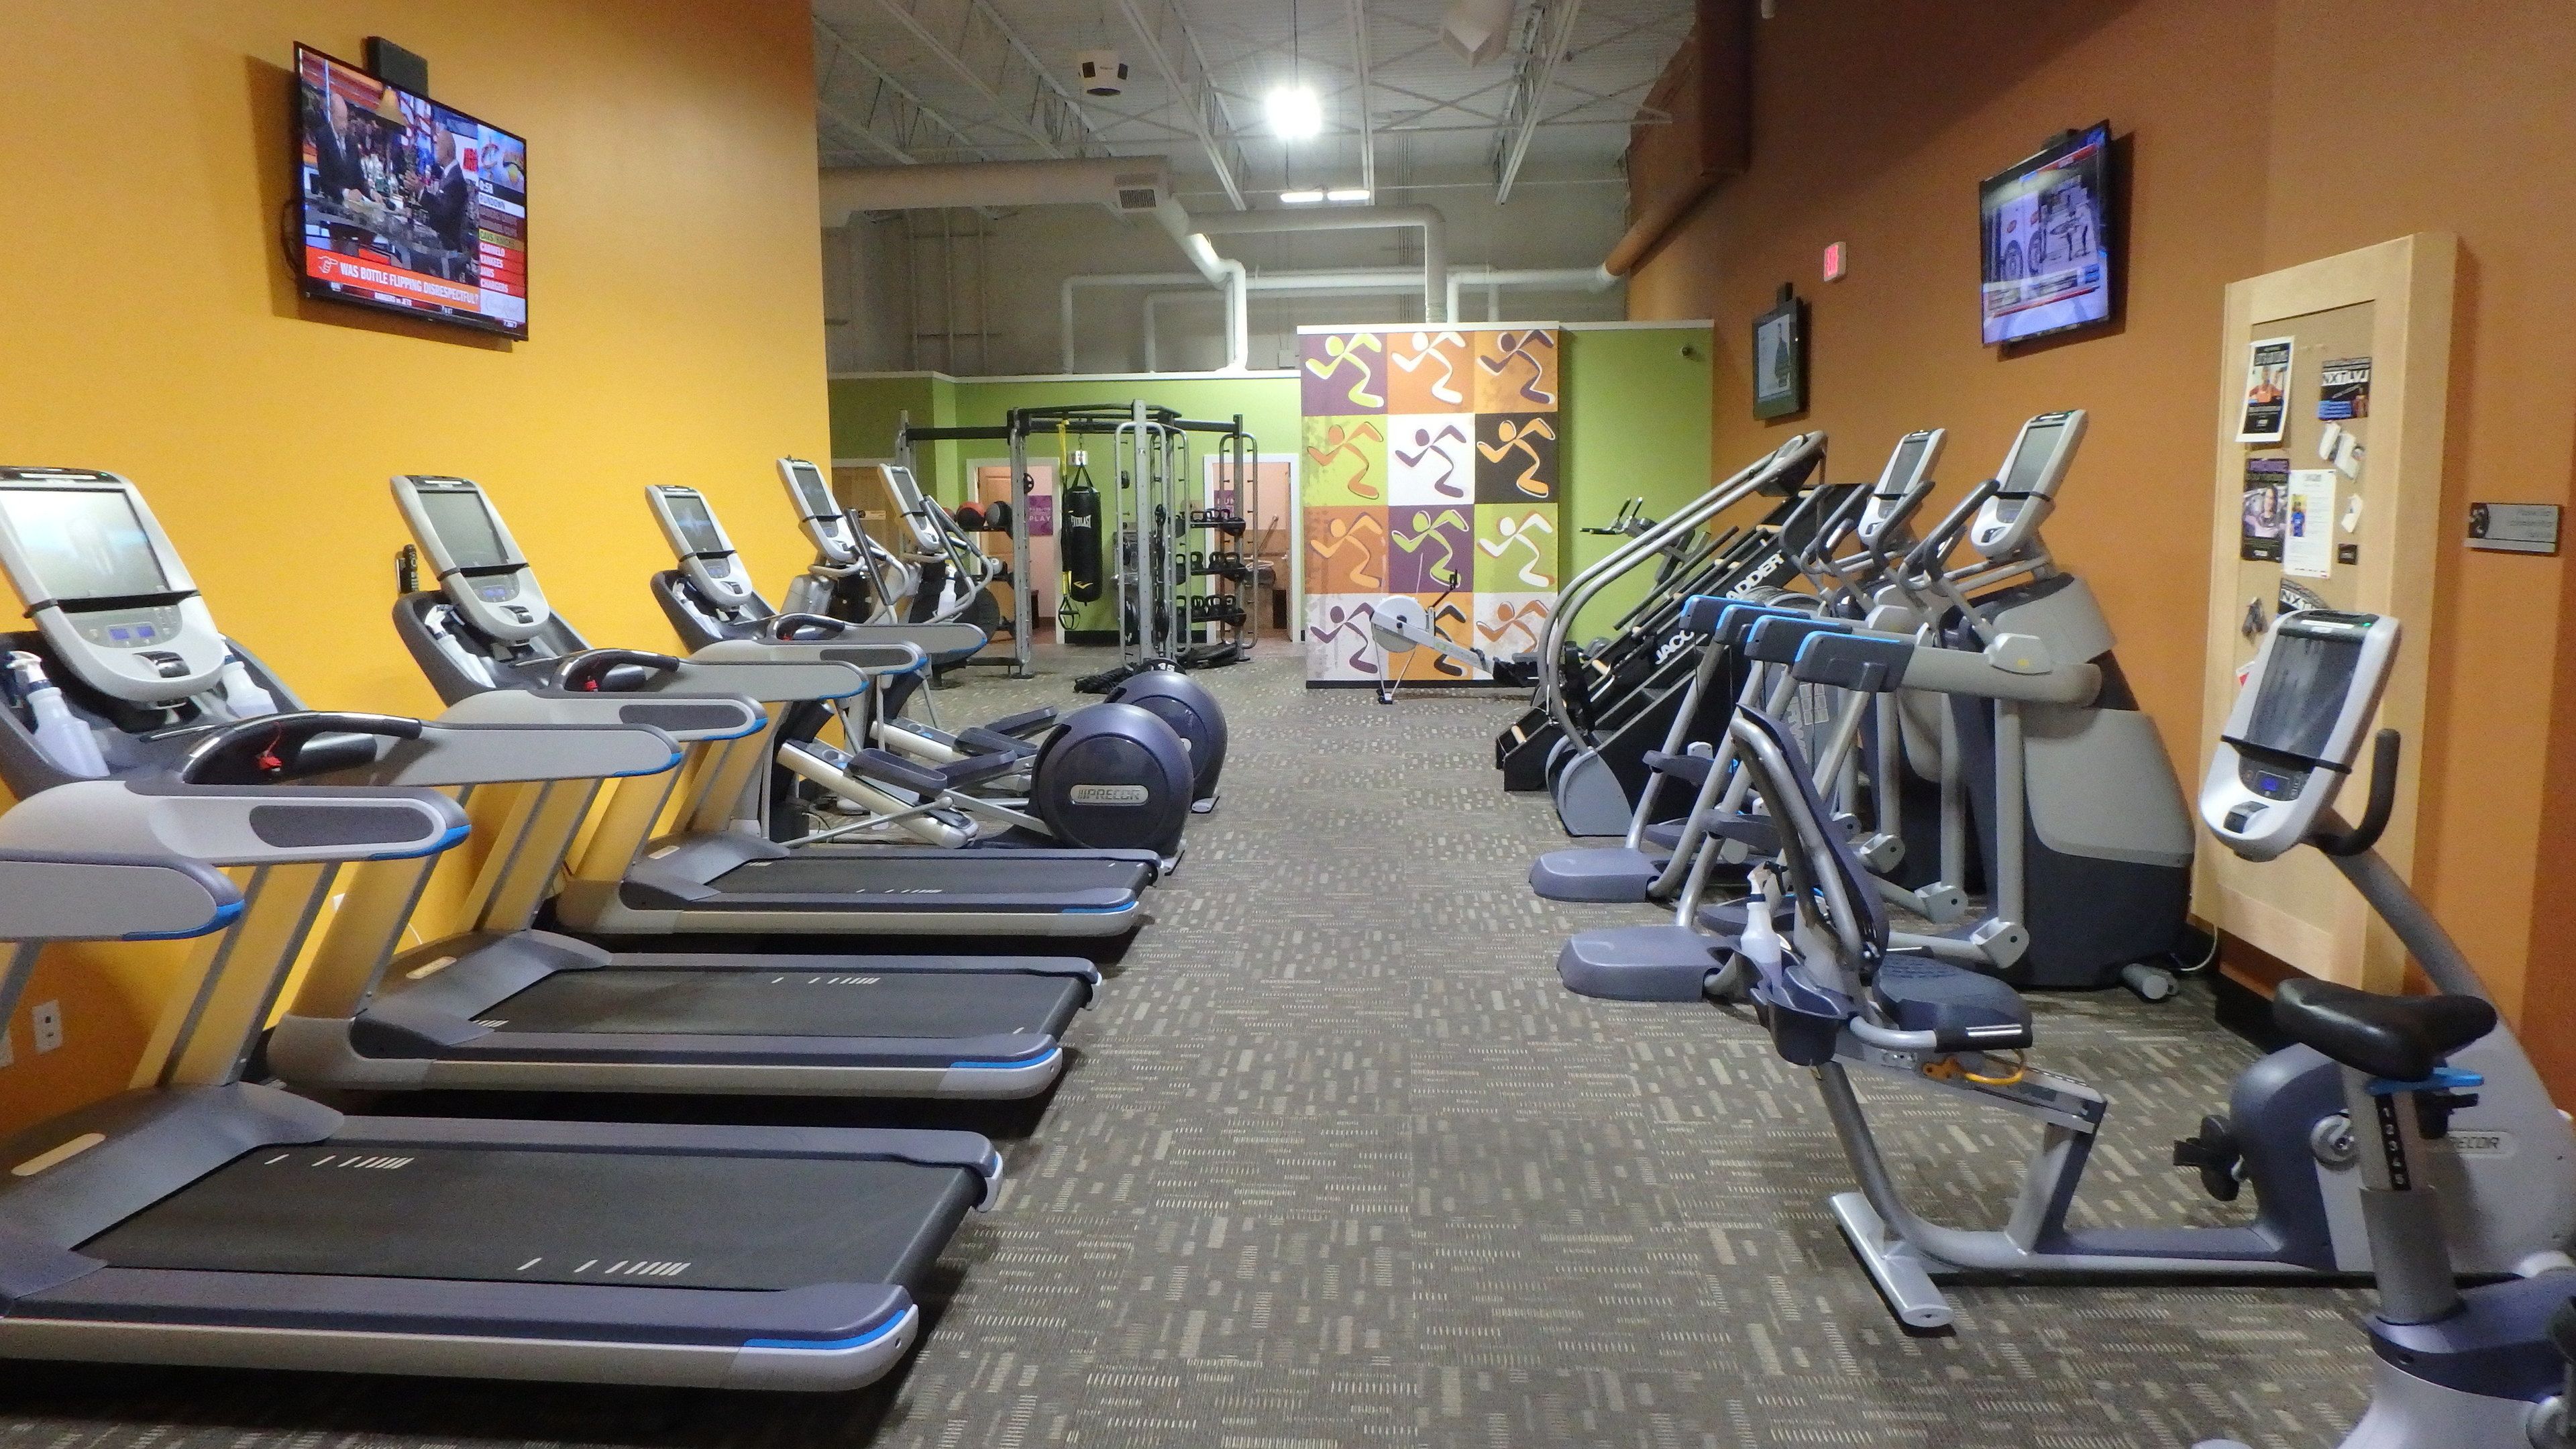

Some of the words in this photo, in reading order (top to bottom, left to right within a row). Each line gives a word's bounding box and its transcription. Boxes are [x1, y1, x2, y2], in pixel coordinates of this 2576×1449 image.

[340, 262, 359, 278] WAS
[361, 267, 388, 284] BOTTLE
[389, 274, 422, 292] FLIPPING
[423, 282, 479, 305] DISRESPECTFUL?
[1158, 662, 1175, 672] 45
[1085, 789, 1140, 800] PRECOR
